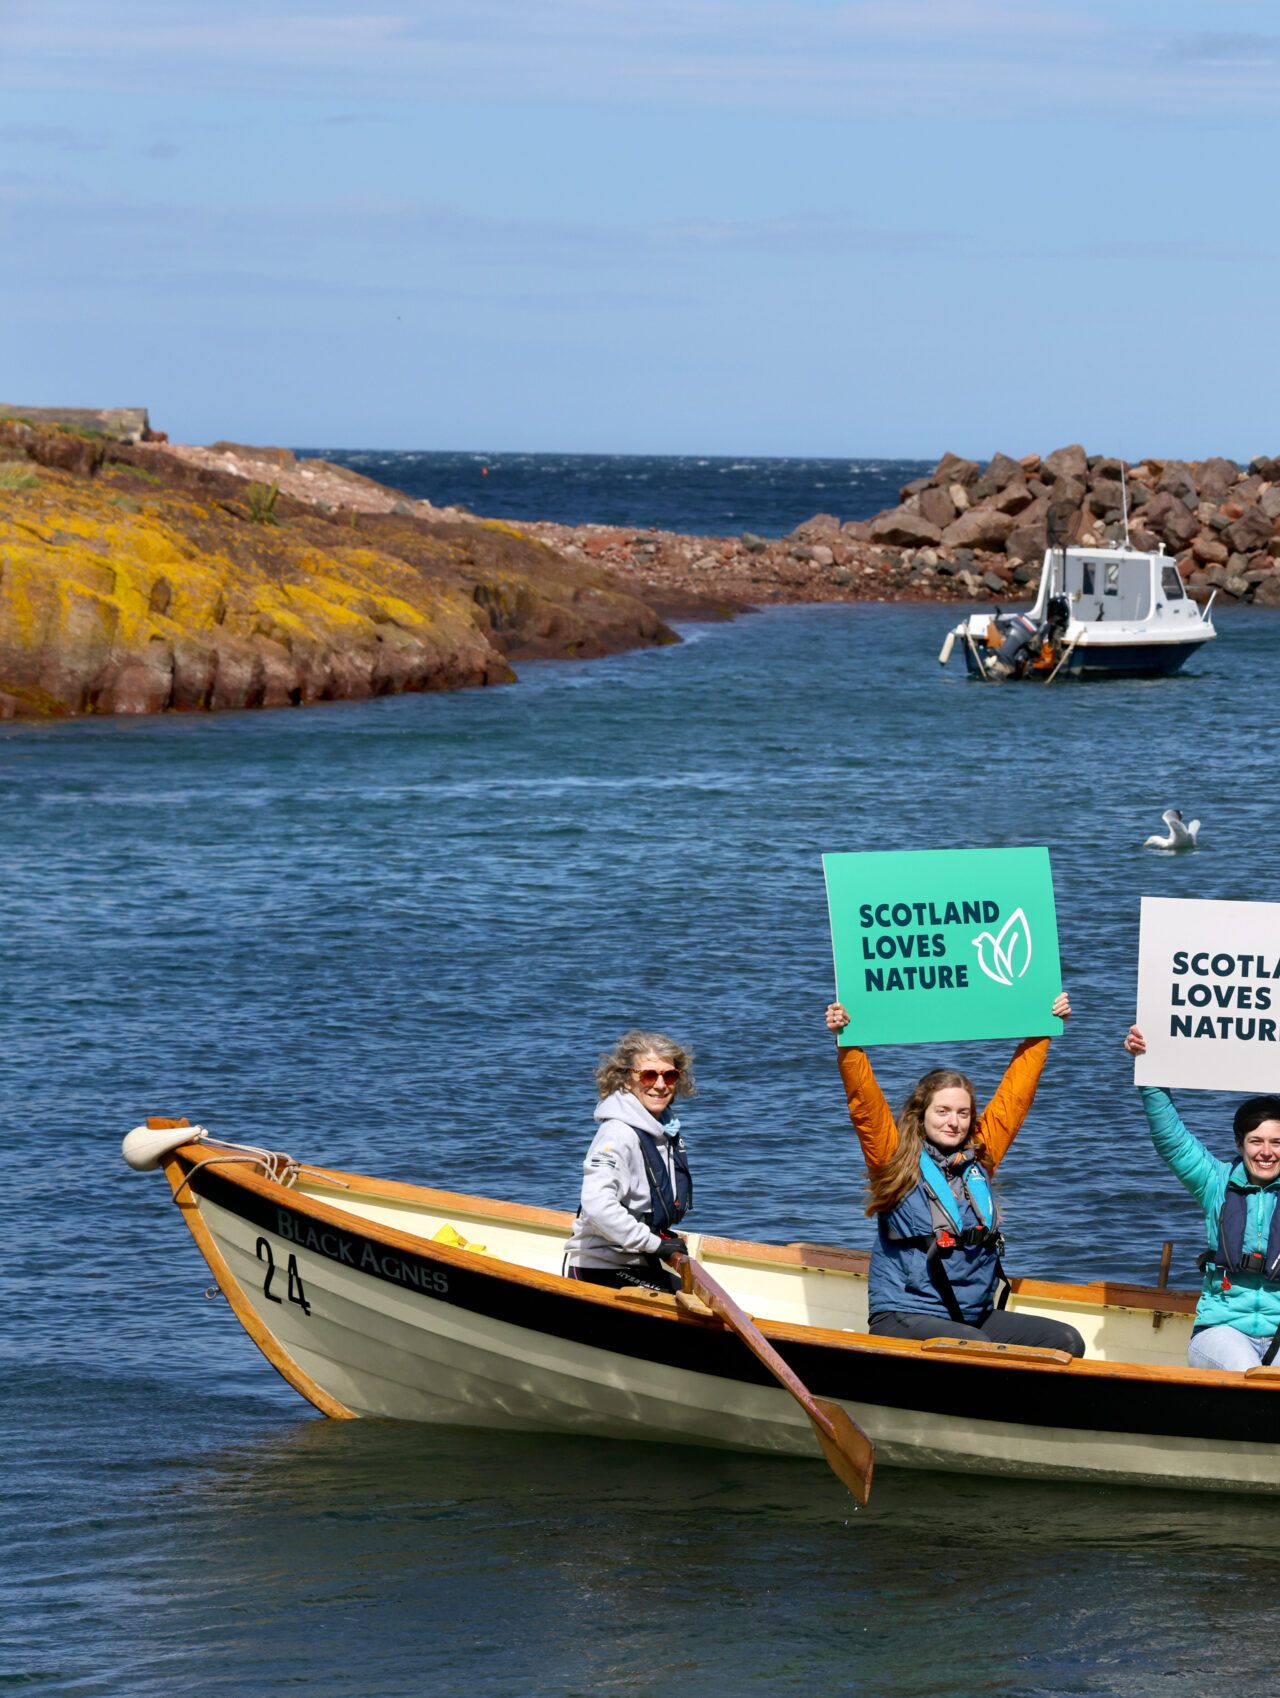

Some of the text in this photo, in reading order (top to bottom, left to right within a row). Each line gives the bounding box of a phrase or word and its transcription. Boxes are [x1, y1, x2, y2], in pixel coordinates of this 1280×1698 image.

[859, 900, 1000, 929] SCOTLAND
[862, 933, 946, 960] LOVES
[865, 964, 969, 992] NATURE
[1171, 984, 1271, 1010] LOVES
[277, 1209, 449, 1293] BLACK AGNES
[256, 1236, 311, 1316] 24
